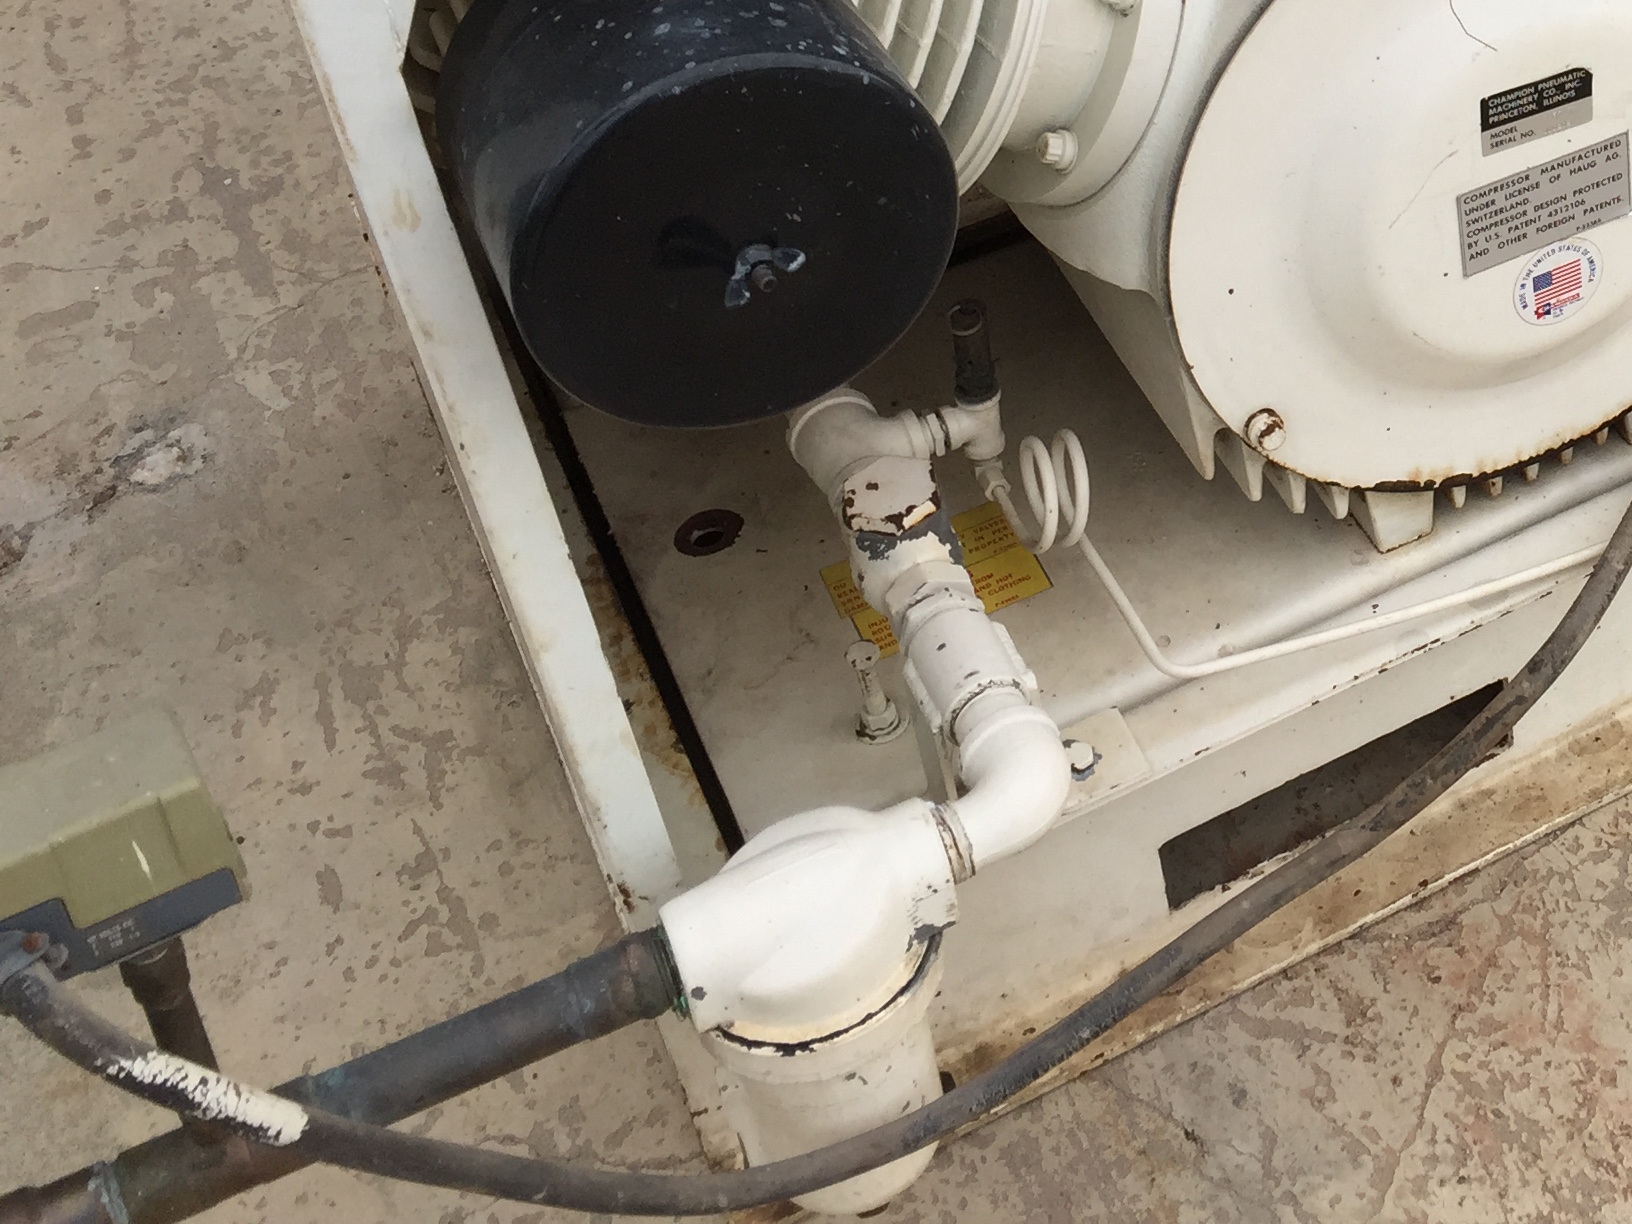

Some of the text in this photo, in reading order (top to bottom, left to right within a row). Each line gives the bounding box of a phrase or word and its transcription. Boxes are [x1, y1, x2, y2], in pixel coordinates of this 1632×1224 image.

[1488, 70, 1586, 107] CHAMPION PNEUMATIC
[1488, 93, 1539, 116] MACHINERY
[1565, 79, 1583, 91] INC.
[1543, 90, 1576, 107] ILLINOIS
[1490, 126, 1518, 140] MODEL
[1490, 136, 1516, 150] SERIAL
[1463, 139, 1621, 205] COMPRESSOR MANUFACTURED
[1464, 198, 1496, 216] UNDER
[1504, 181, 1540, 201] LICENSE
[1548, 173, 1561, 184] OF
[1569, 160, 1597, 176] HAUG
[1465, 197, 1532, 228] SWITZERLAND.
[1466, 172, 1623, 239] COMPRESSOR DESIGN PROTECTED
[1467, 239, 1480, 251] BY
[1508, 214, 1542, 234] PATENT
[1547, 198, 1586, 218] 4312106
[1468, 195, 1624, 261] AND OTHER FOREIGN PATENTS.
[1532, 248, 1556, 268] UNITED
[1558, 244, 1582, 253] STATES
[1581, 248, 1590, 256] OF
[1522, 268, 1534, 281] THE
[1587, 256, 1596, 283] AMERICA
[1519, 292, 1528, 310] MADE
[968, 531, 1015, 554] PROPERTY
[988, 574, 1032, 596] CLOTHING
